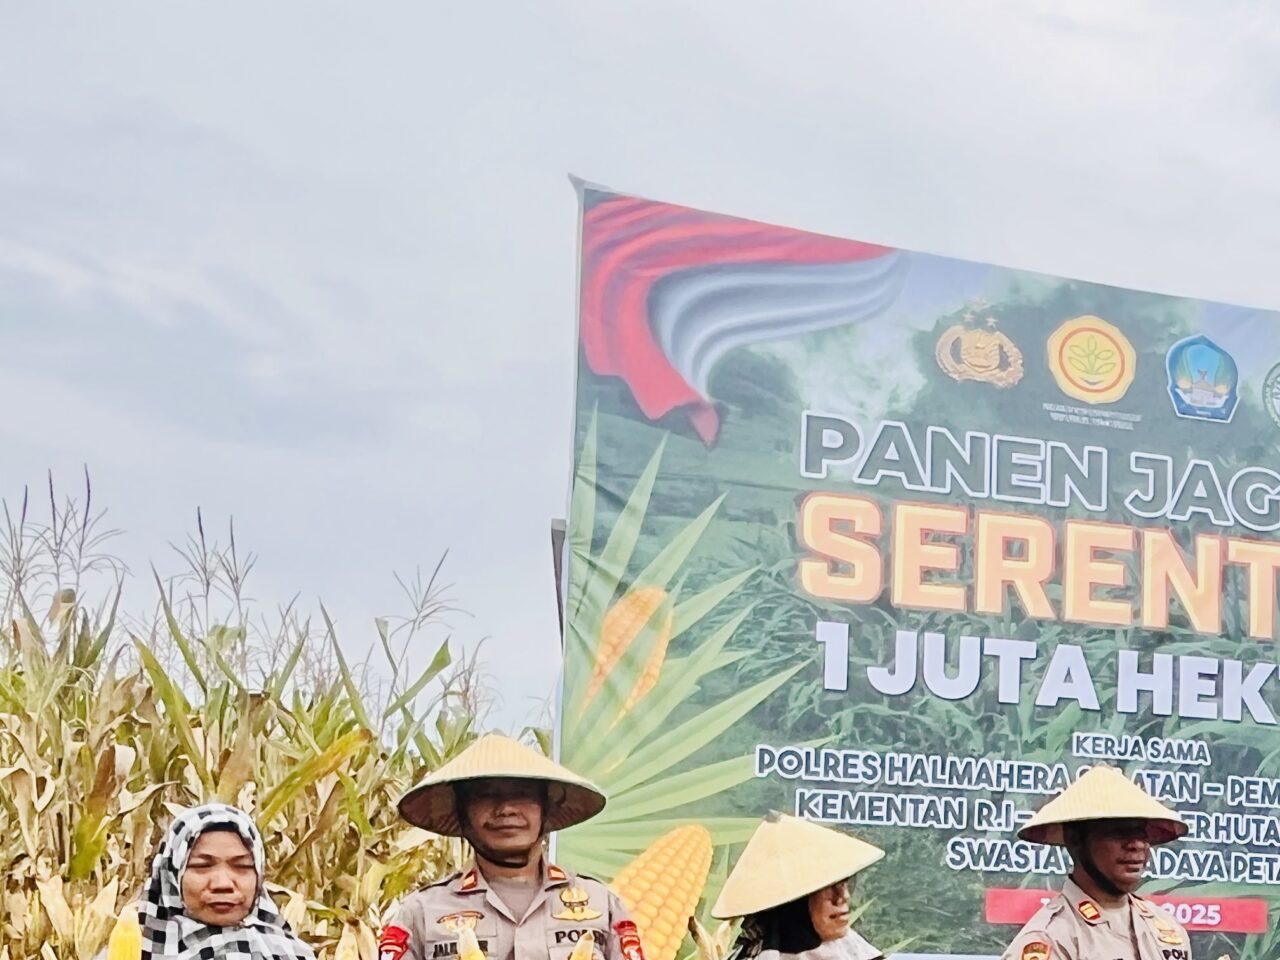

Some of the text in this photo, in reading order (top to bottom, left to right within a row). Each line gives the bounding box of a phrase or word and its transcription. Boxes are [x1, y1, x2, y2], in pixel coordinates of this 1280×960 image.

[801, 410, 1107, 511] PANEN
[816, 621, 849, 690] 1
[866, 630, 1100, 711] JUTA
[755, 745, 881, 784] POLRES
[885, 752, 1072, 793] HALMAHERA
[1073, 732, 1211, 766] KERJA SAMA
[796, 789, 967, 829] KEMENTAN
